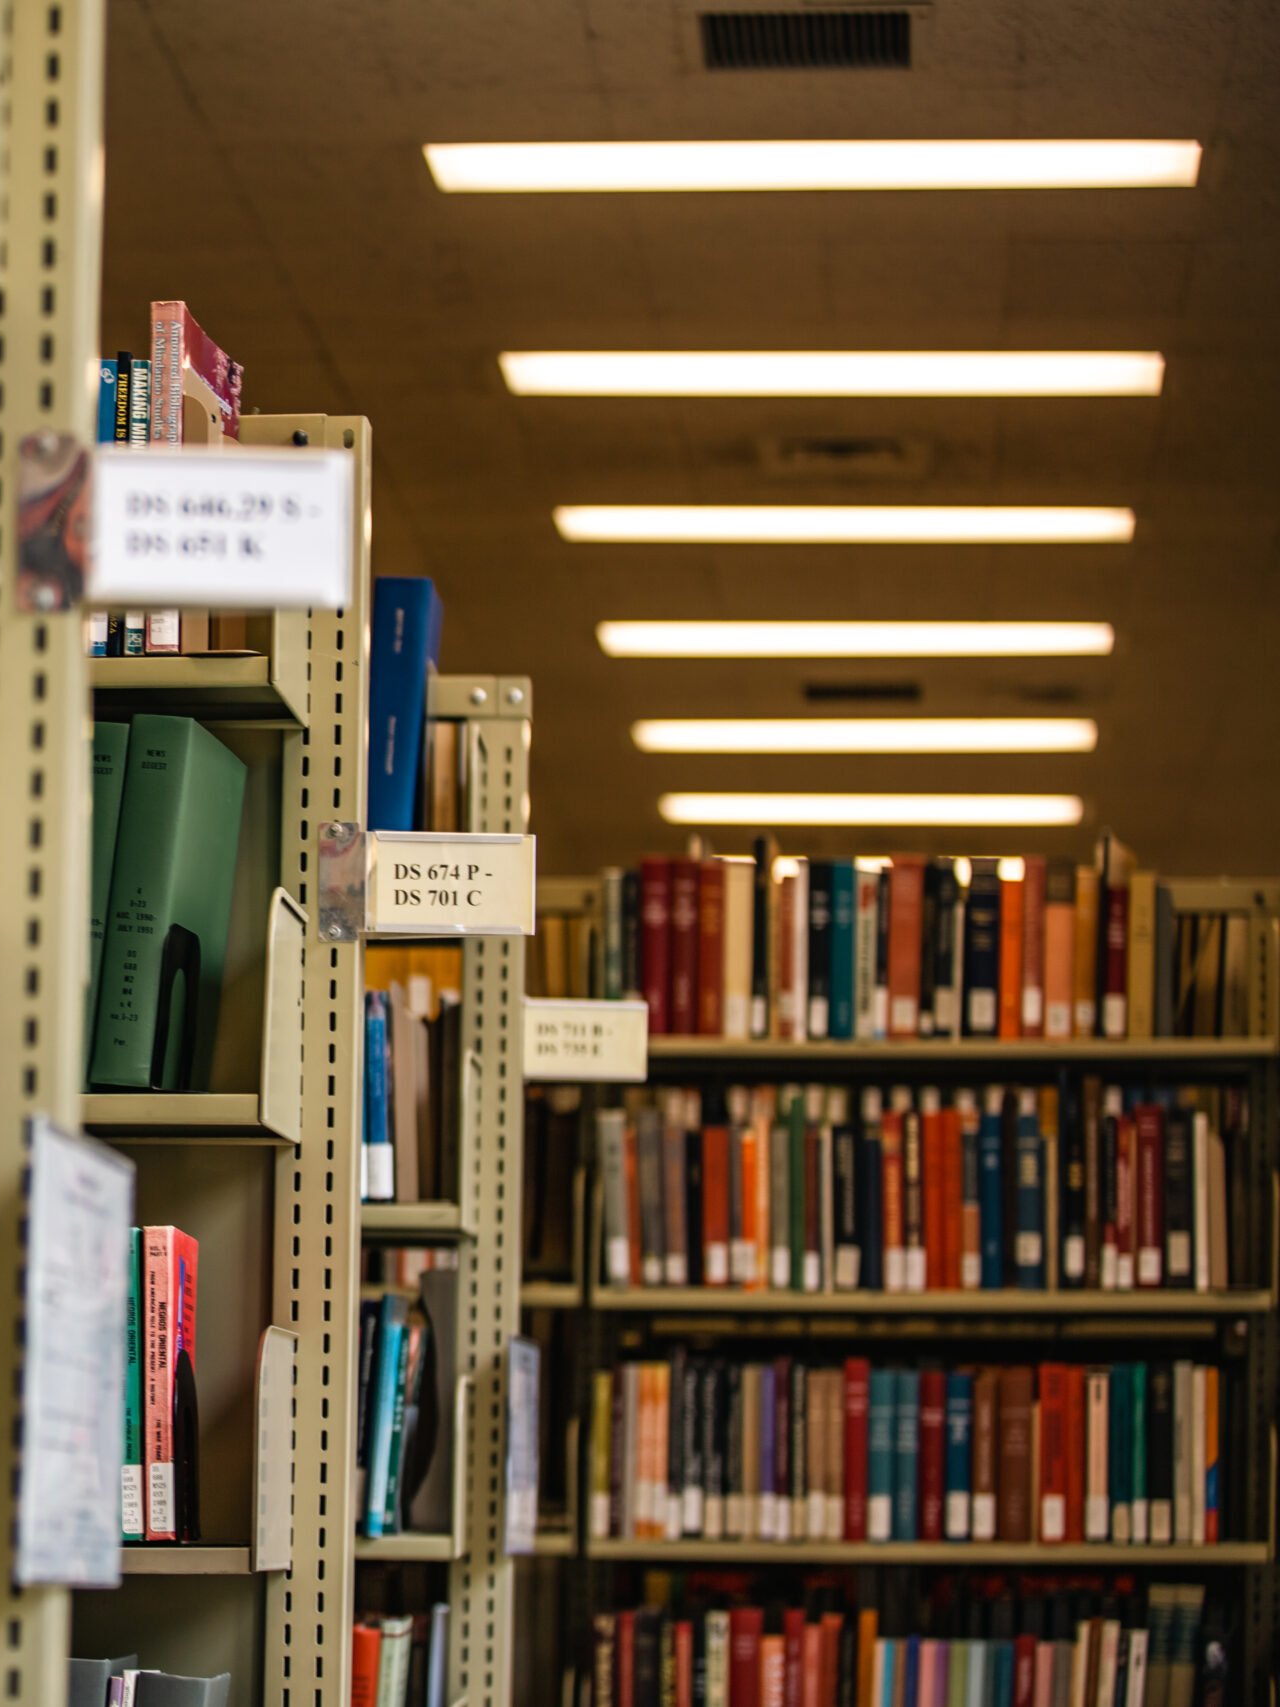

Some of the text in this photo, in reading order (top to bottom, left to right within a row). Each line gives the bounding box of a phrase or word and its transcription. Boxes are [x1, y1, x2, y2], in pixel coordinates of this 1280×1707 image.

[155, 321, 166, 334] of
[170, 321, 182, 380] Annotated
[154, 338, 166, 395] Mindanao
[116, 374, 128, 425] FREEDOM
[131, 368, 148, 420] MAKING
[146, 749, 167, 758] NEWS
[394, 863, 421, 881] DS
[427, 864, 460, 881] 674
[467, 864, 480, 881] P
[394, 889, 482, 907] DS 701 C
[128, 1297, 136, 1365] NEGROS ORIENTAL
[157, 1301, 167, 1370] NEGROS ORIENTAL
